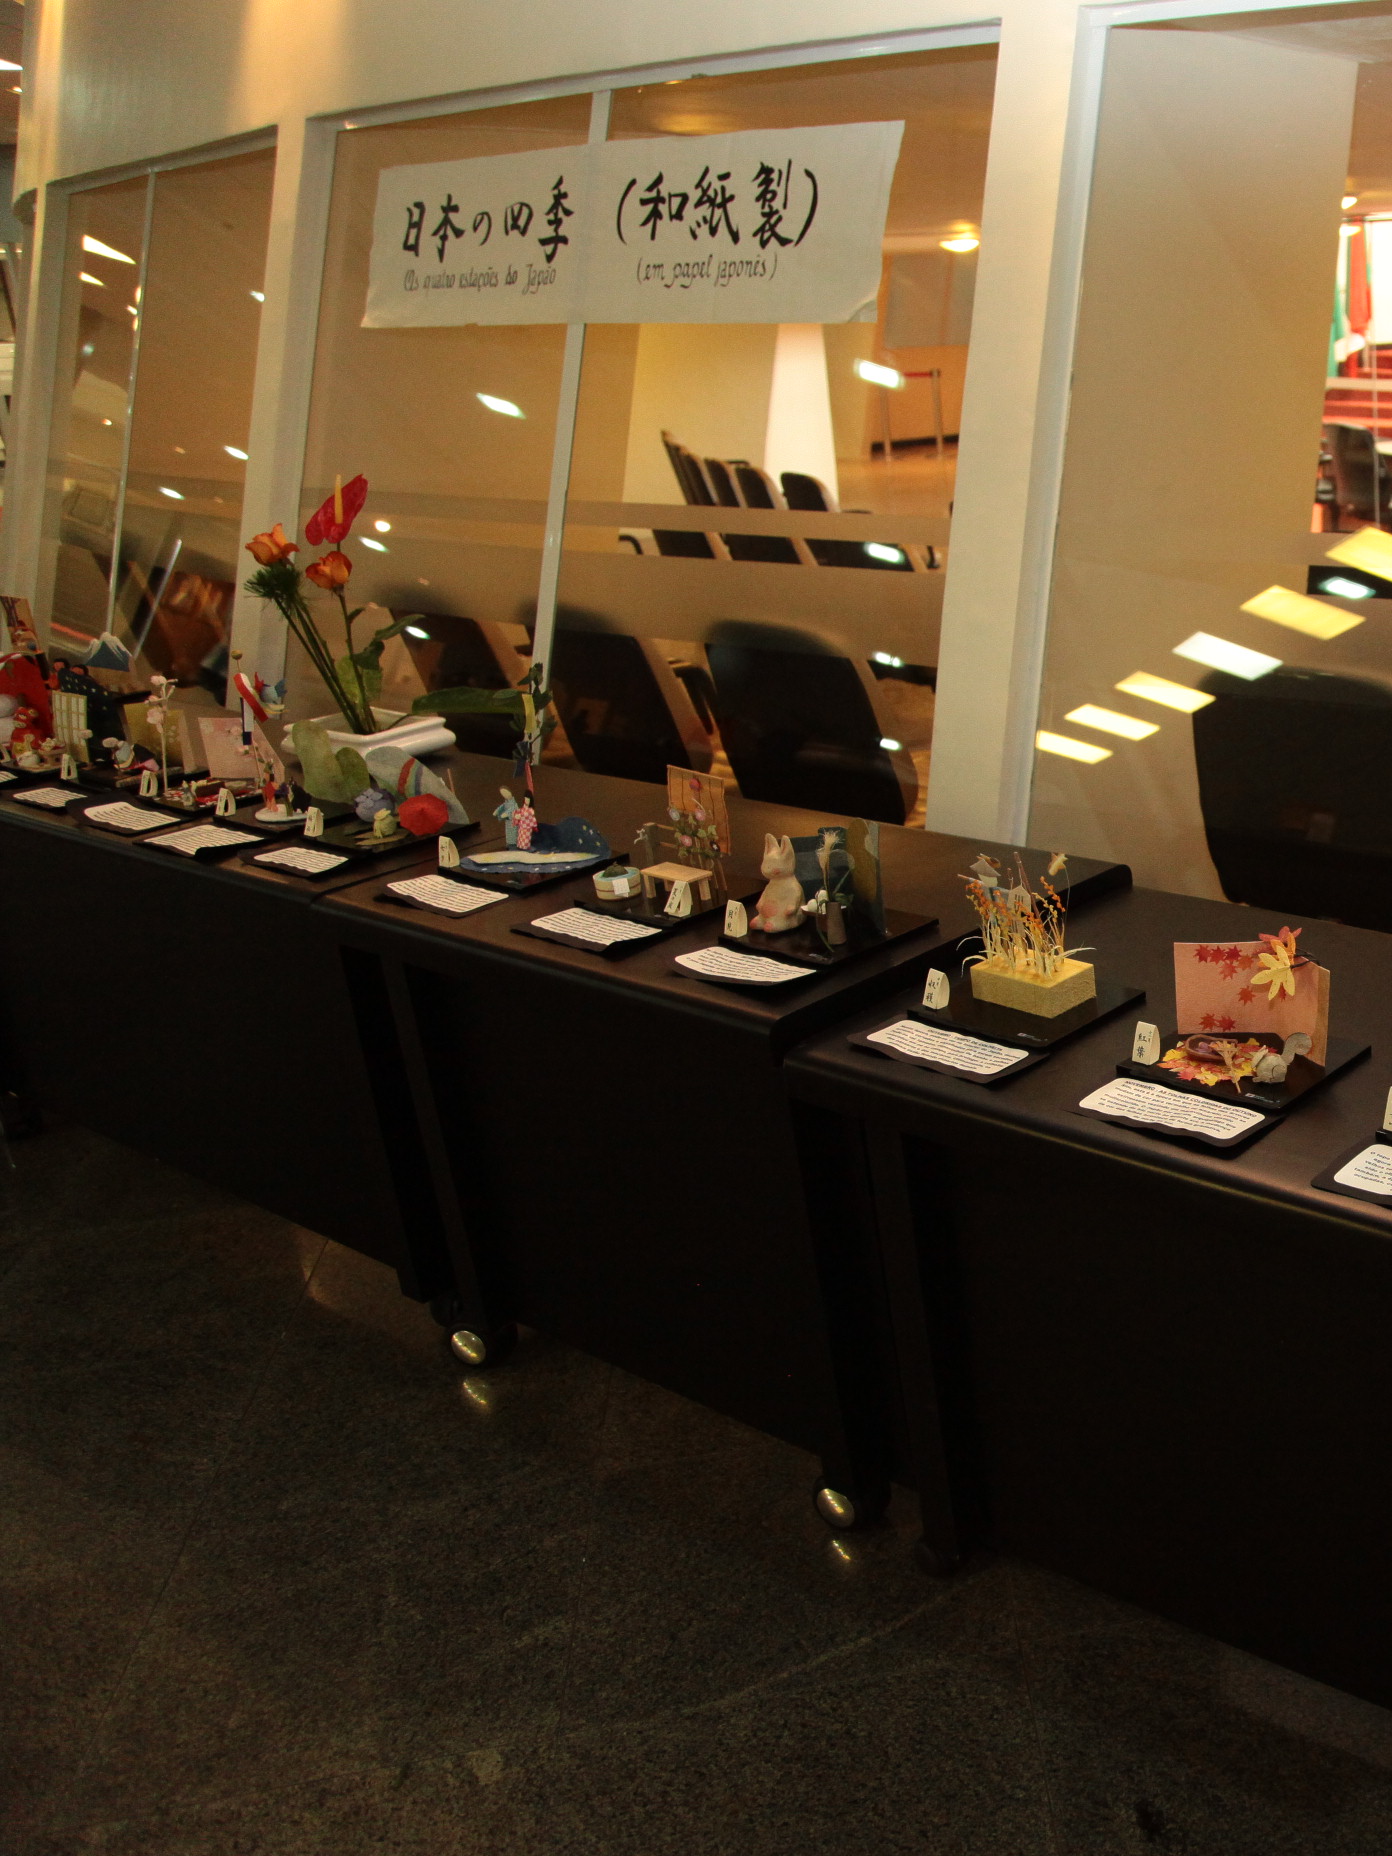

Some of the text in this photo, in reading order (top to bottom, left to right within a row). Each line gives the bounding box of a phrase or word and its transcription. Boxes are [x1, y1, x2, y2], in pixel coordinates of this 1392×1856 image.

[402, 176, 574, 263] 日本の四季
[521, 263, 557, 295] Japão
[664, 253, 713, 289] papel
